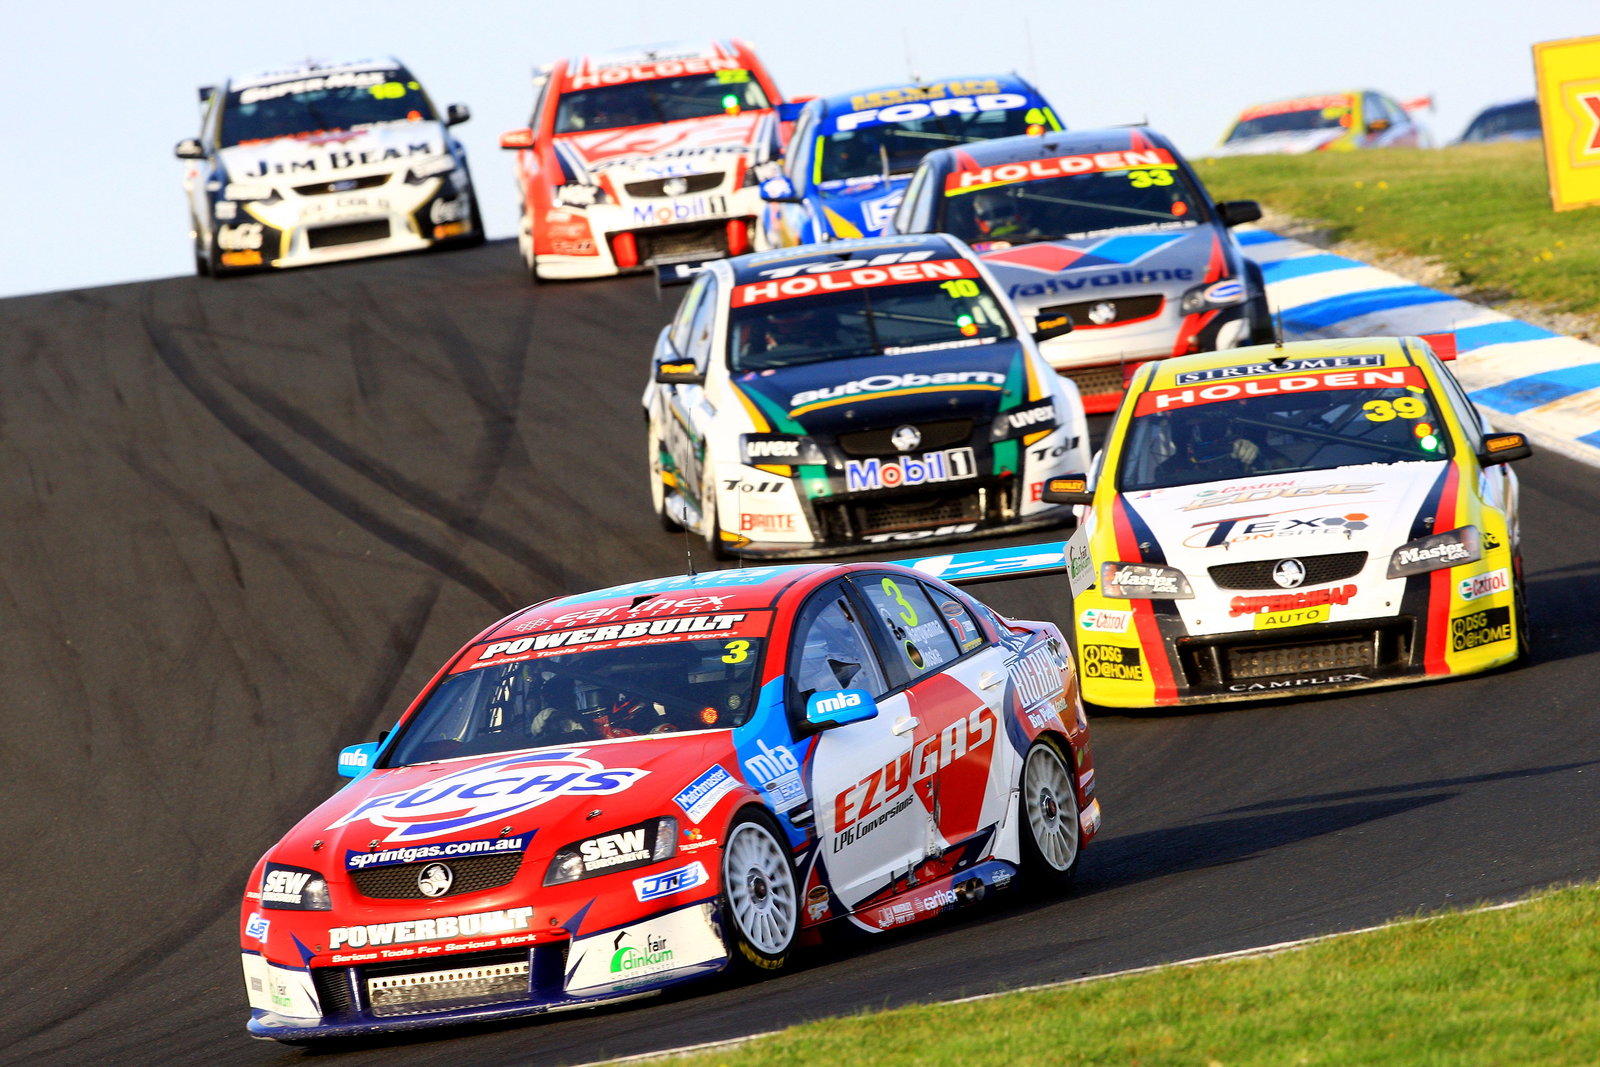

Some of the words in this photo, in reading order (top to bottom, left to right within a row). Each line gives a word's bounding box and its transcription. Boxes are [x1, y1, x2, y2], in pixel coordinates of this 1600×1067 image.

[573, 58, 740, 89] HOLDEN
[836, 94, 1027, 131] FORD
[246, 159, 317, 178] JIM
[329, 143, 431, 168] BEAM
[960, 150, 1162, 188] HOLDEN
[1128, 168, 1174, 189] 33
[759, 250, 936, 279] Toll
[743, 262, 961, 303] HOLDEN
[939, 279, 981, 299] 10
[1182, 355, 1379, 383] SIRROMET
[1156, 370, 1405, 408] HOLDEN
[1008, 405, 1055, 429] uvex
[1362, 396, 1427, 423] 39
[747, 440, 800, 457] uvex
[1032, 436, 1080, 461] Toll
[845, 451, 946, 493] Mobil
[949, 449, 974, 480] 1
[722, 479, 785, 495] Toll
[1177, 483, 1383, 512] EDGE
[1222, 480, 1298, 495] Castrol
[861, 523, 978, 543] Toll
[1192, 514, 1326, 547] TEX
[1231, 530, 1341, 544] ONSITE
[1399, 543, 1465, 566] Master
[1112, 569, 1177, 586] Master
[552, 594, 737, 625] earthex
[881, 578, 918, 627] 3
[1229, 584, 1358, 618] SUPERCHEAP
[1096, 612, 1127, 630] Castrol
[1265, 609, 1320, 625] AUTO
[1466, 612, 1488, 631] DSG
[470, 653, 529, 669] Serious
[536, 645, 578, 660] Tools
[582, 641, 613, 653] For
[617, 633, 682, 648] Serious
[687, 630, 735, 643] Work
[478, 614, 747, 661] POWERBUILT
[721, 640, 750, 664] 3
[1100, 646, 1123, 663] DSG
[1101, 662, 1143, 680] @HOME
[1229, 673, 1371, 692] CAMPLEX
[815, 691, 862, 714] mfa
[339, 748, 368, 767] mfa
[744, 739, 799, 784] mfa
[340, 770, 636, 824] FUCHS
[833, 831, 856, 855] LPG
[855, 794, 914, 840] Conversions
[348, 837, 522, 869] sprintgas.com.au
[580, 829, 646, 864] SEW
[263, 870, 313, 896] SEW
[329, 906, 535, 950] POWERBUILT
[332, 952, 377, 964] Serious
[381, 948, 415, 959] Tools
[417, 945, 442, 956] For
[445, 939, 498, 953] Serious
[501, 933, 537, 946] Work
[647, 934, 667, 954] fair
[622, 948, 674, 972] dinkum
